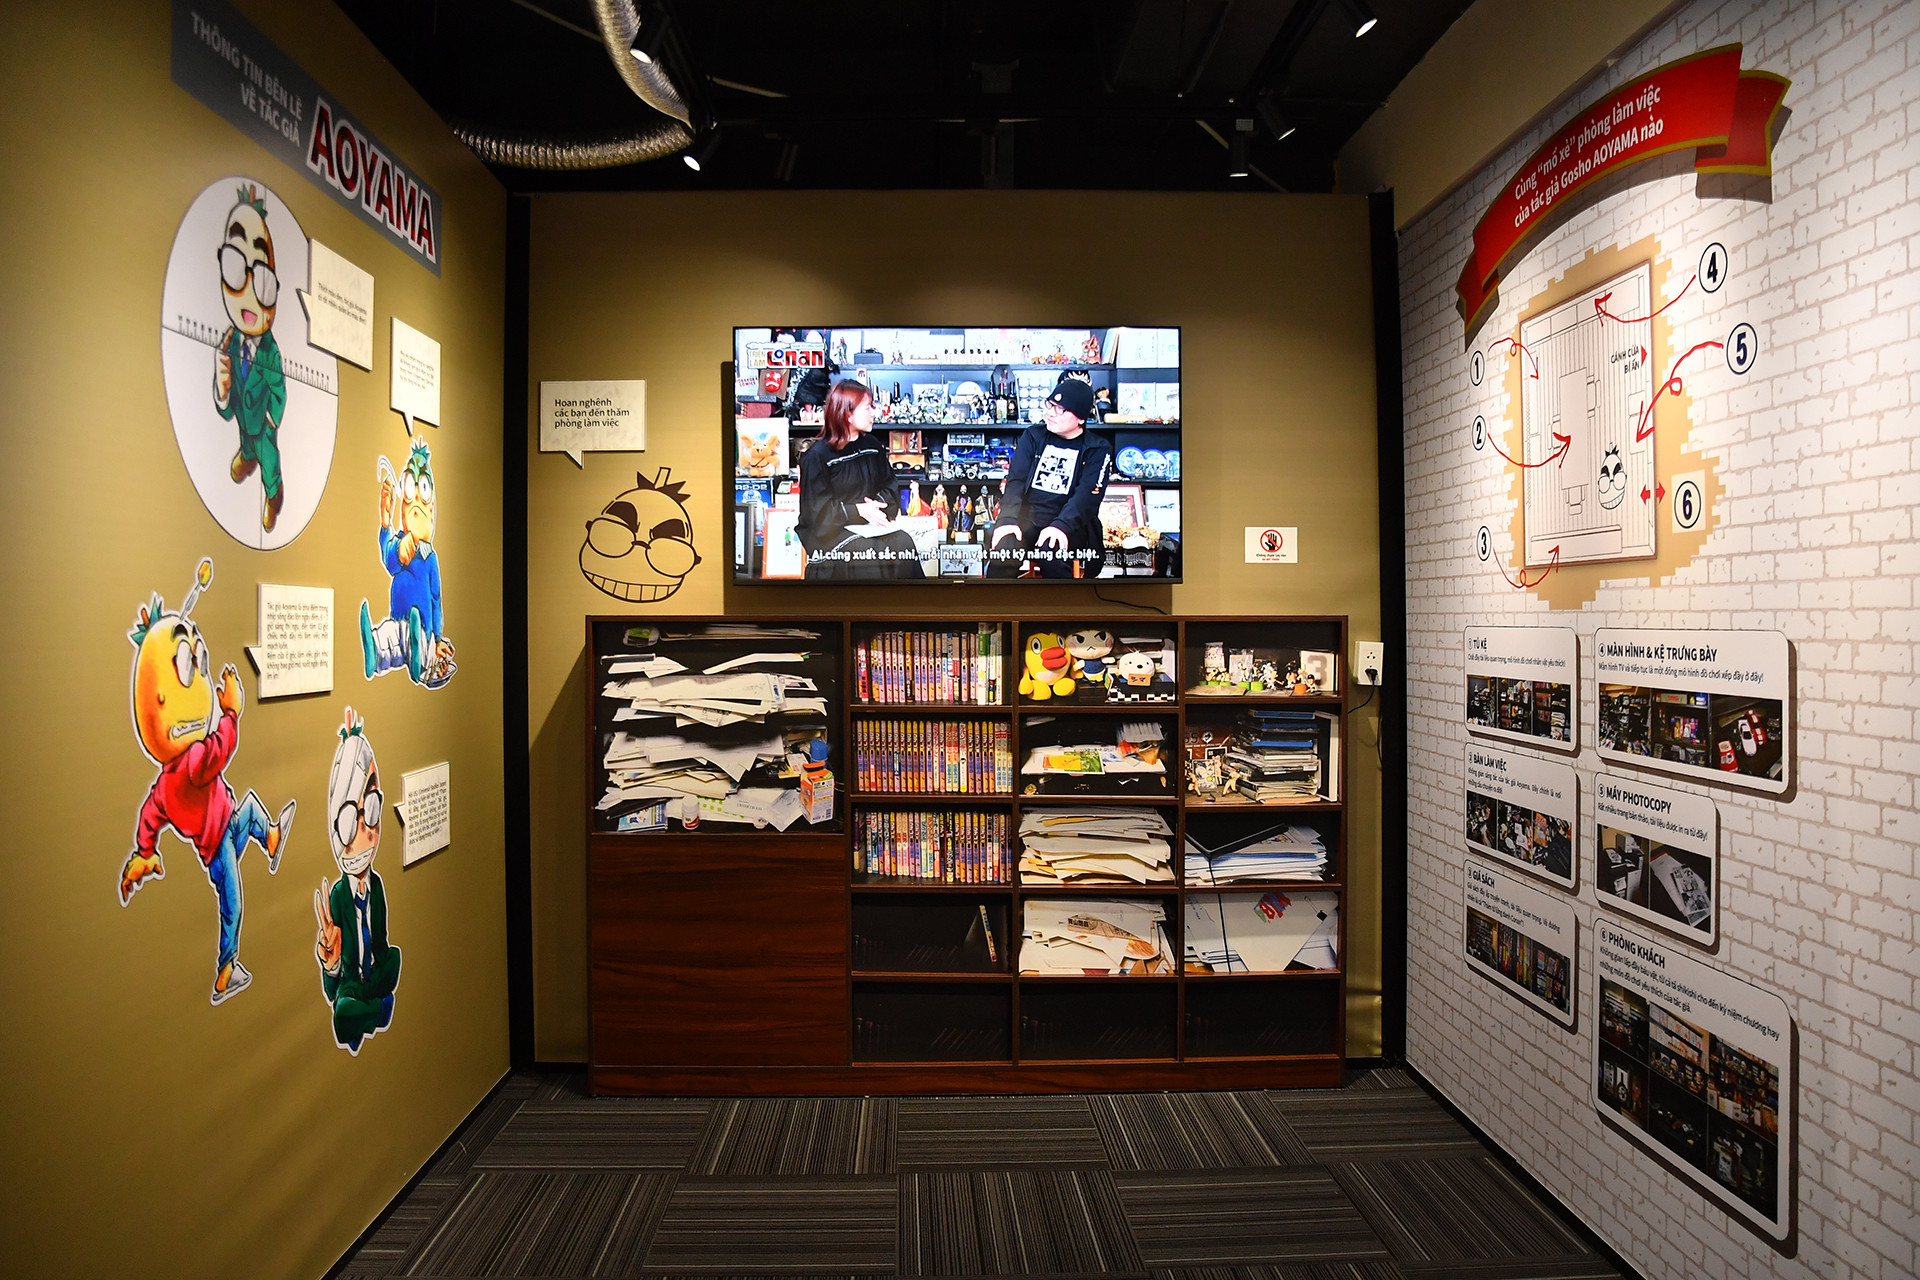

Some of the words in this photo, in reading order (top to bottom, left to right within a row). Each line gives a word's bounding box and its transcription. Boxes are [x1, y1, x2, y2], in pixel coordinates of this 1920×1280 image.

[191, 11, 240, 70] THÔNG
[242, 54, 263, 88] TIN
[265, 74, 288, 109] BÊN
[258, 96, 280, 131] TÁC
[1515, 170, 1537, 200] Cùng
[1577, 114, 1610, 153] phòng
[1612, 101, 1634, 126] làm
[1636, 84, 1660, 112] việc
[306, 98, 436, 264] AOYAMA
[1514, 205, 1530, 228] của
[1530, 190, 1544, 213] tác
[1545, 175, 1560, 206] giả
[1560, 158, 1592, 189] Gosho
[1592, 126, 1639, 169] AOYAMA
[1640, 114, 1664, 142] nào
[554, 399, 578, 407] Hoan
[579, 398, 612, 408] nghênh
[554, 408, 569, 417] các
[571, 408, 587, 420] bạn
[588, 407, 605, 417] đến
[606, 408, 630, 416] thăm
[554, 418, 582, 429] phòng
[584, 418, 600, 427] làm
[602, 418, 619, 429] việc
[811, 549, 823, 560] Ai
[852, 548, 877, 560] xuất
[878, 546, 896, 560] sắc
[942, 549, 969, 560] nhân
[971, 549, 988, 562] vật
[990, 550, 1011, 562] một
[1027, 548, 1053, 561] năng
[1055, 549, 1074, 562] đặc
[1076, 549, 1100, 562] biệt.
[1606, 642, 1624, 657] MÀN
[1624, 644, 1644, 658] HÌNH
[1646, 646, 1653, 658] &
[1654, 644, 1665, 663] KỆ
[1666, 645, 1698, 661] TRƯNG
[1700, 645, 1717, 662] BÀY
[1617, 663, 1623, 671] TV
[1308, 654, 1328, 684] 3
[1473, 752, 1484, 765] BÀN
[1484, 754, 1495, 768] LÀM
[1494, 758, 1507, 773] VIỆC
[1606, 785, 1622, 801] MÁY
[1622, 791, 1672, 814] PHOTOCOPY
[1481, 872, 1495, 888] SÁCH
[1609, 931, 1636, 955] PHÒNG
[1637, 947, 1665, 968] KHÁCH
[1696, 991, 1707, 1005] cho
[1767, 1025, 1779, 1042] hay
